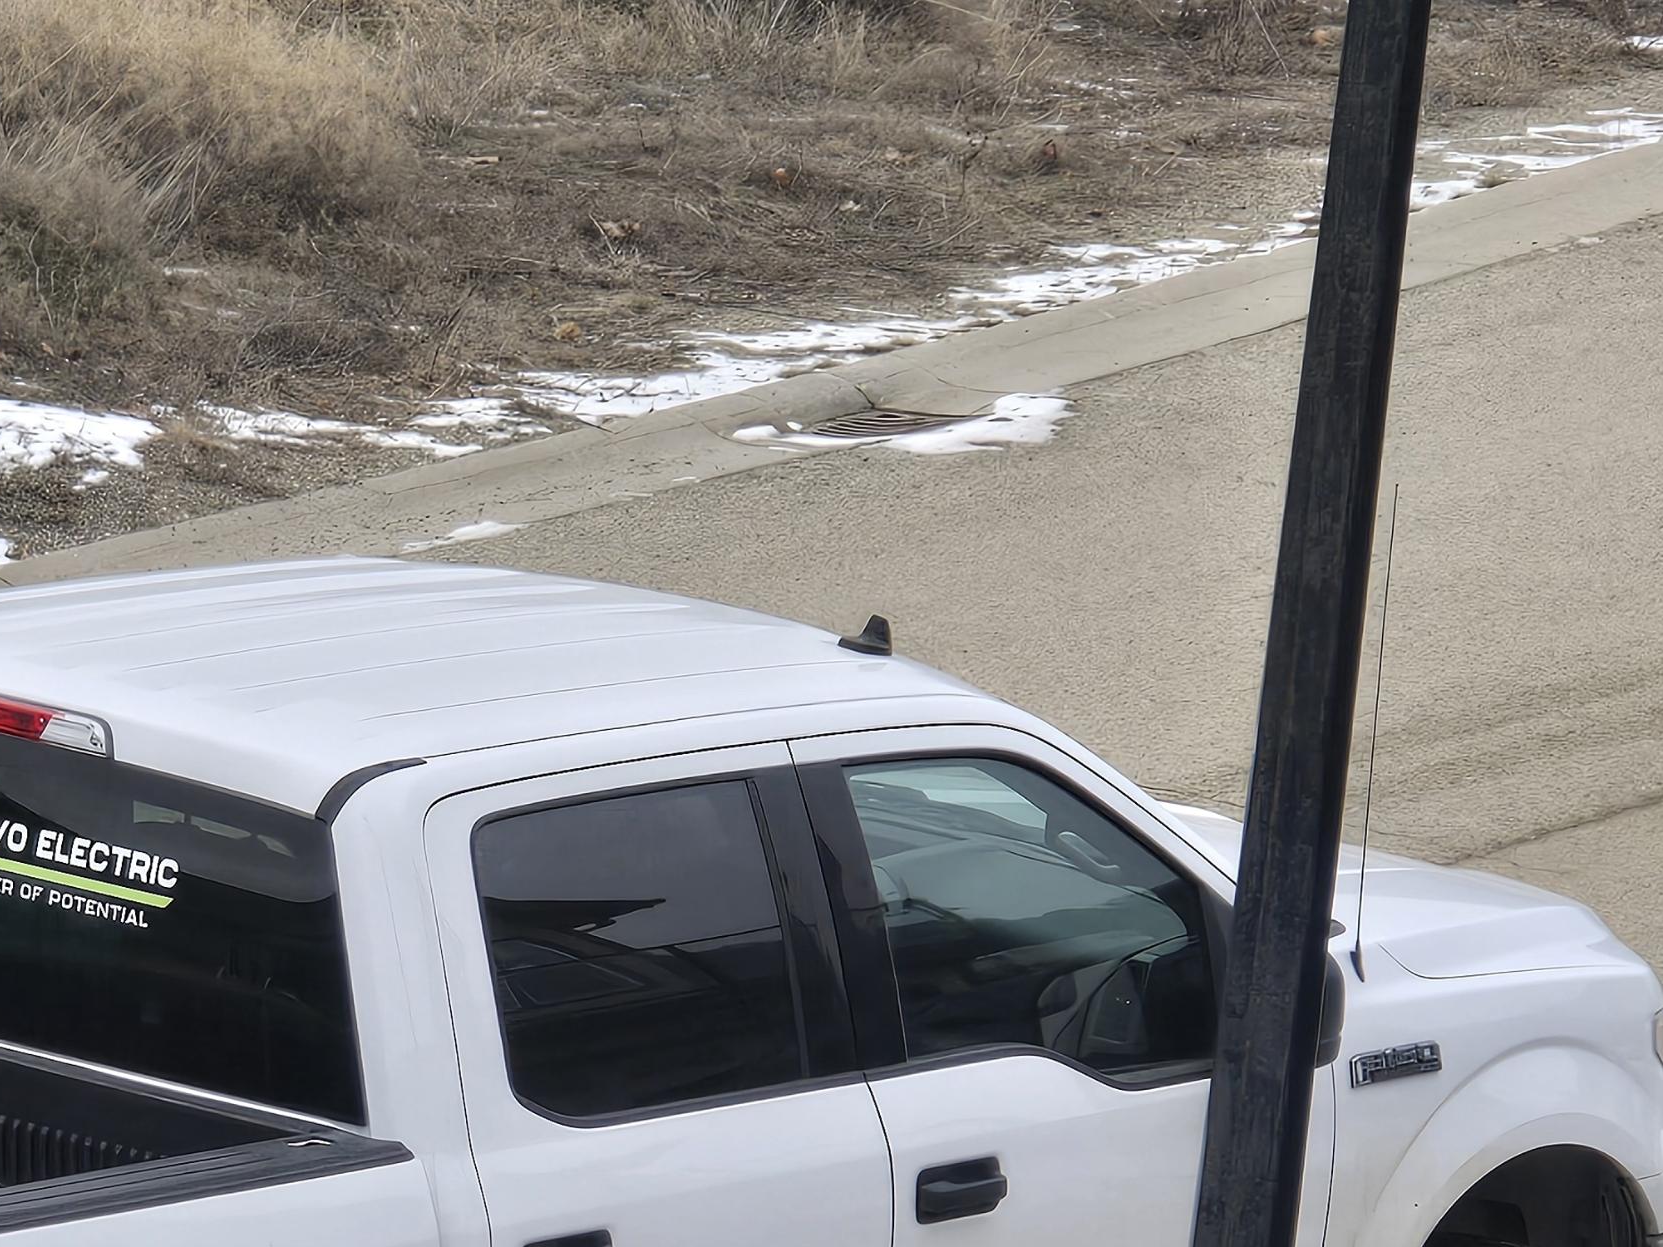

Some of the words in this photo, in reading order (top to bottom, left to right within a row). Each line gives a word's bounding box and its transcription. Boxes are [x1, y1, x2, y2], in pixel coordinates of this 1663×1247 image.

[34, 829, 181, 889] ELECTRIC
[20, 882, 45, 902] OF
[47, 889, 150, 929] POTENTIAL
